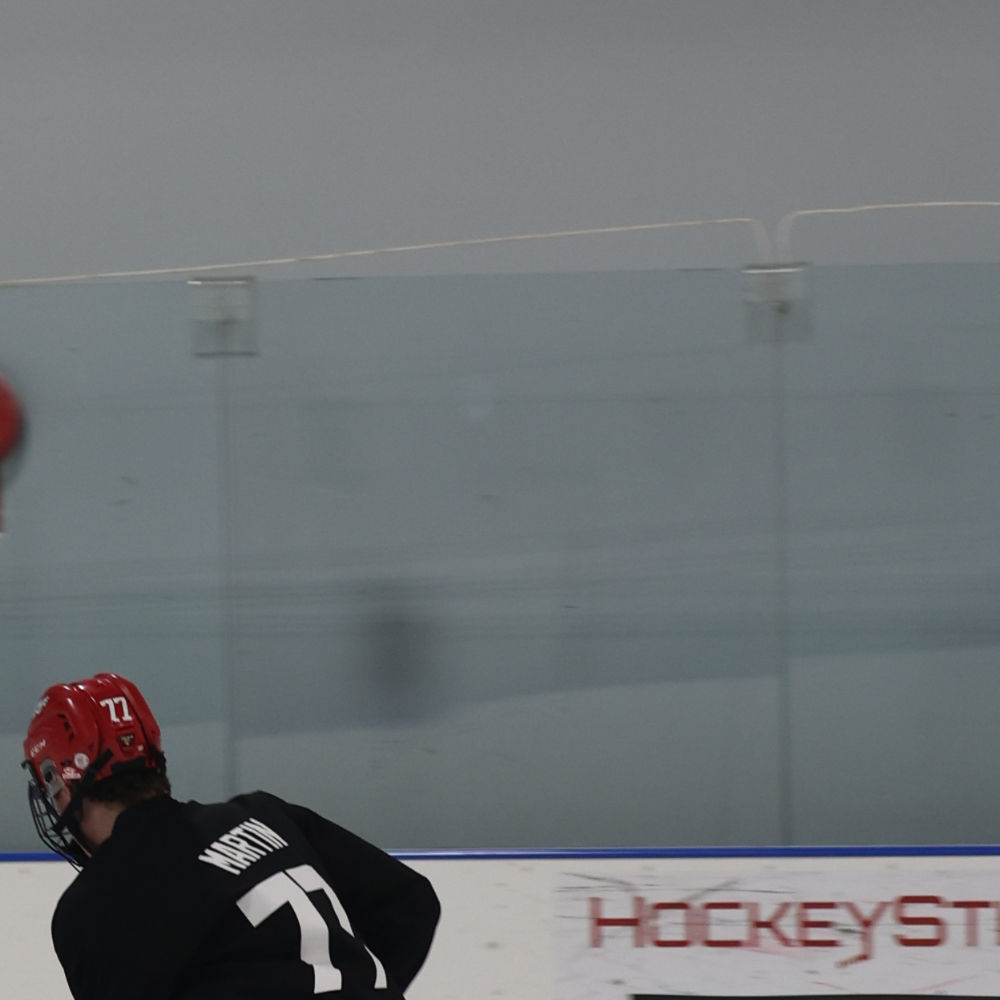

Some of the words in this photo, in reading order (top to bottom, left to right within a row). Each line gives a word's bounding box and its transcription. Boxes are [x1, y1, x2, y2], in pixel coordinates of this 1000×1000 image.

[100, 696, 133, 723] 77
[198, 817, 289, 875] MARTIN
[236, 864, 388, 994] 77
